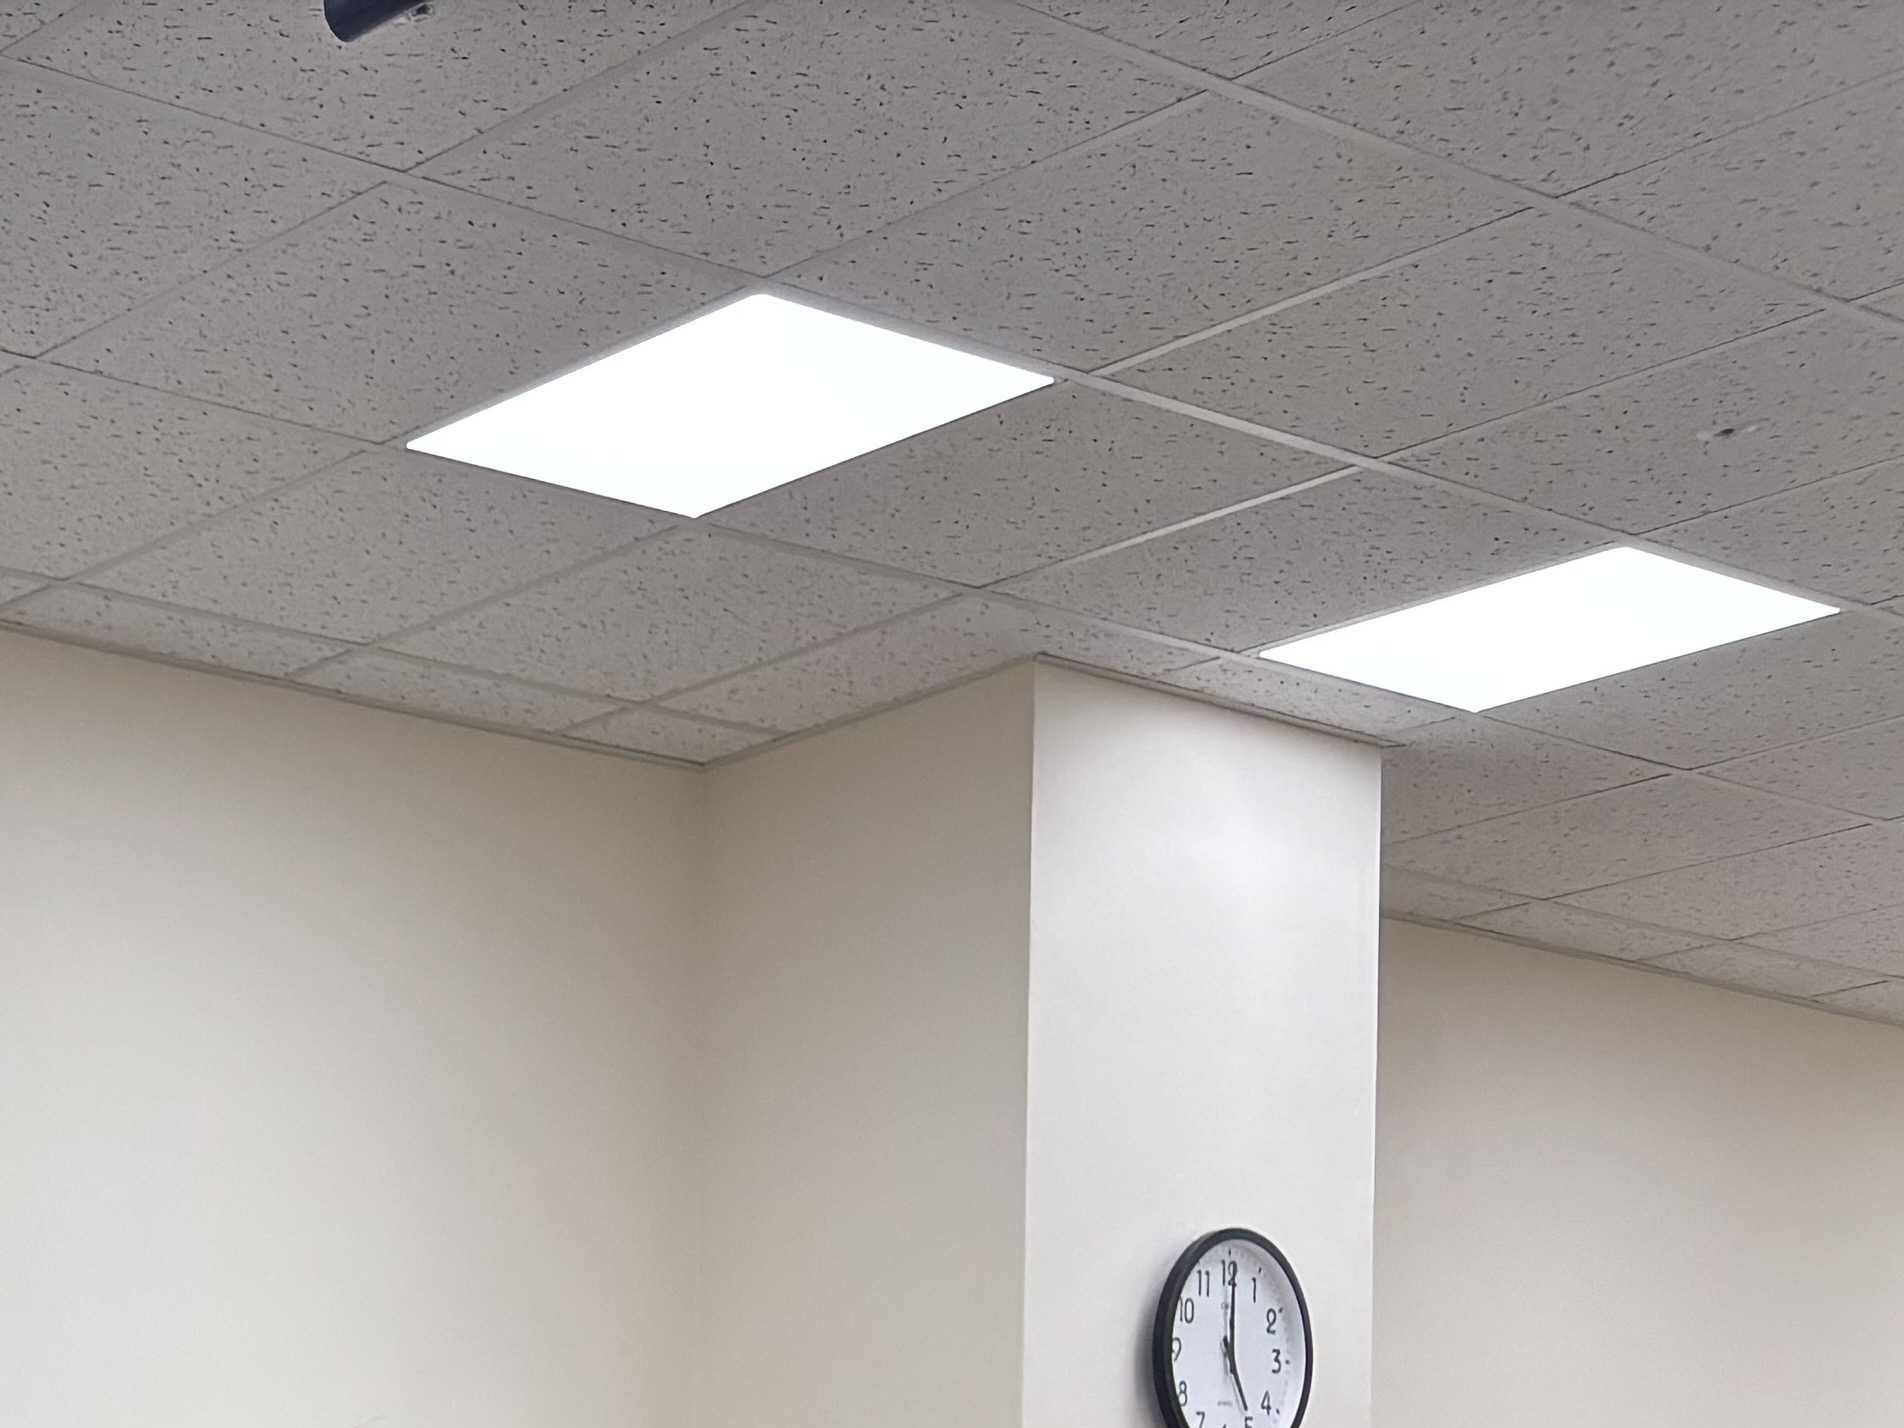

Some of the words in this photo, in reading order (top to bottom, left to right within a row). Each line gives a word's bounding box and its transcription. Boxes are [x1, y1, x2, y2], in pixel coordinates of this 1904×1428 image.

[1197, 1269, 1210, 1297] 11
[1221, 1259, 1238, 1287] 12
[1251, 1277, 1257, 1303] 1
[1178, 1296, 1194, 1324] 10
[1266, 1308, 1276, 1335] 2
[1172, 1337, 1182, 1362] 9
[1272, 1349, 1282, 1374] 3
[1179, 1380, 1188, 1407] 8
[1261, 1390, 1271, 1416] 4
